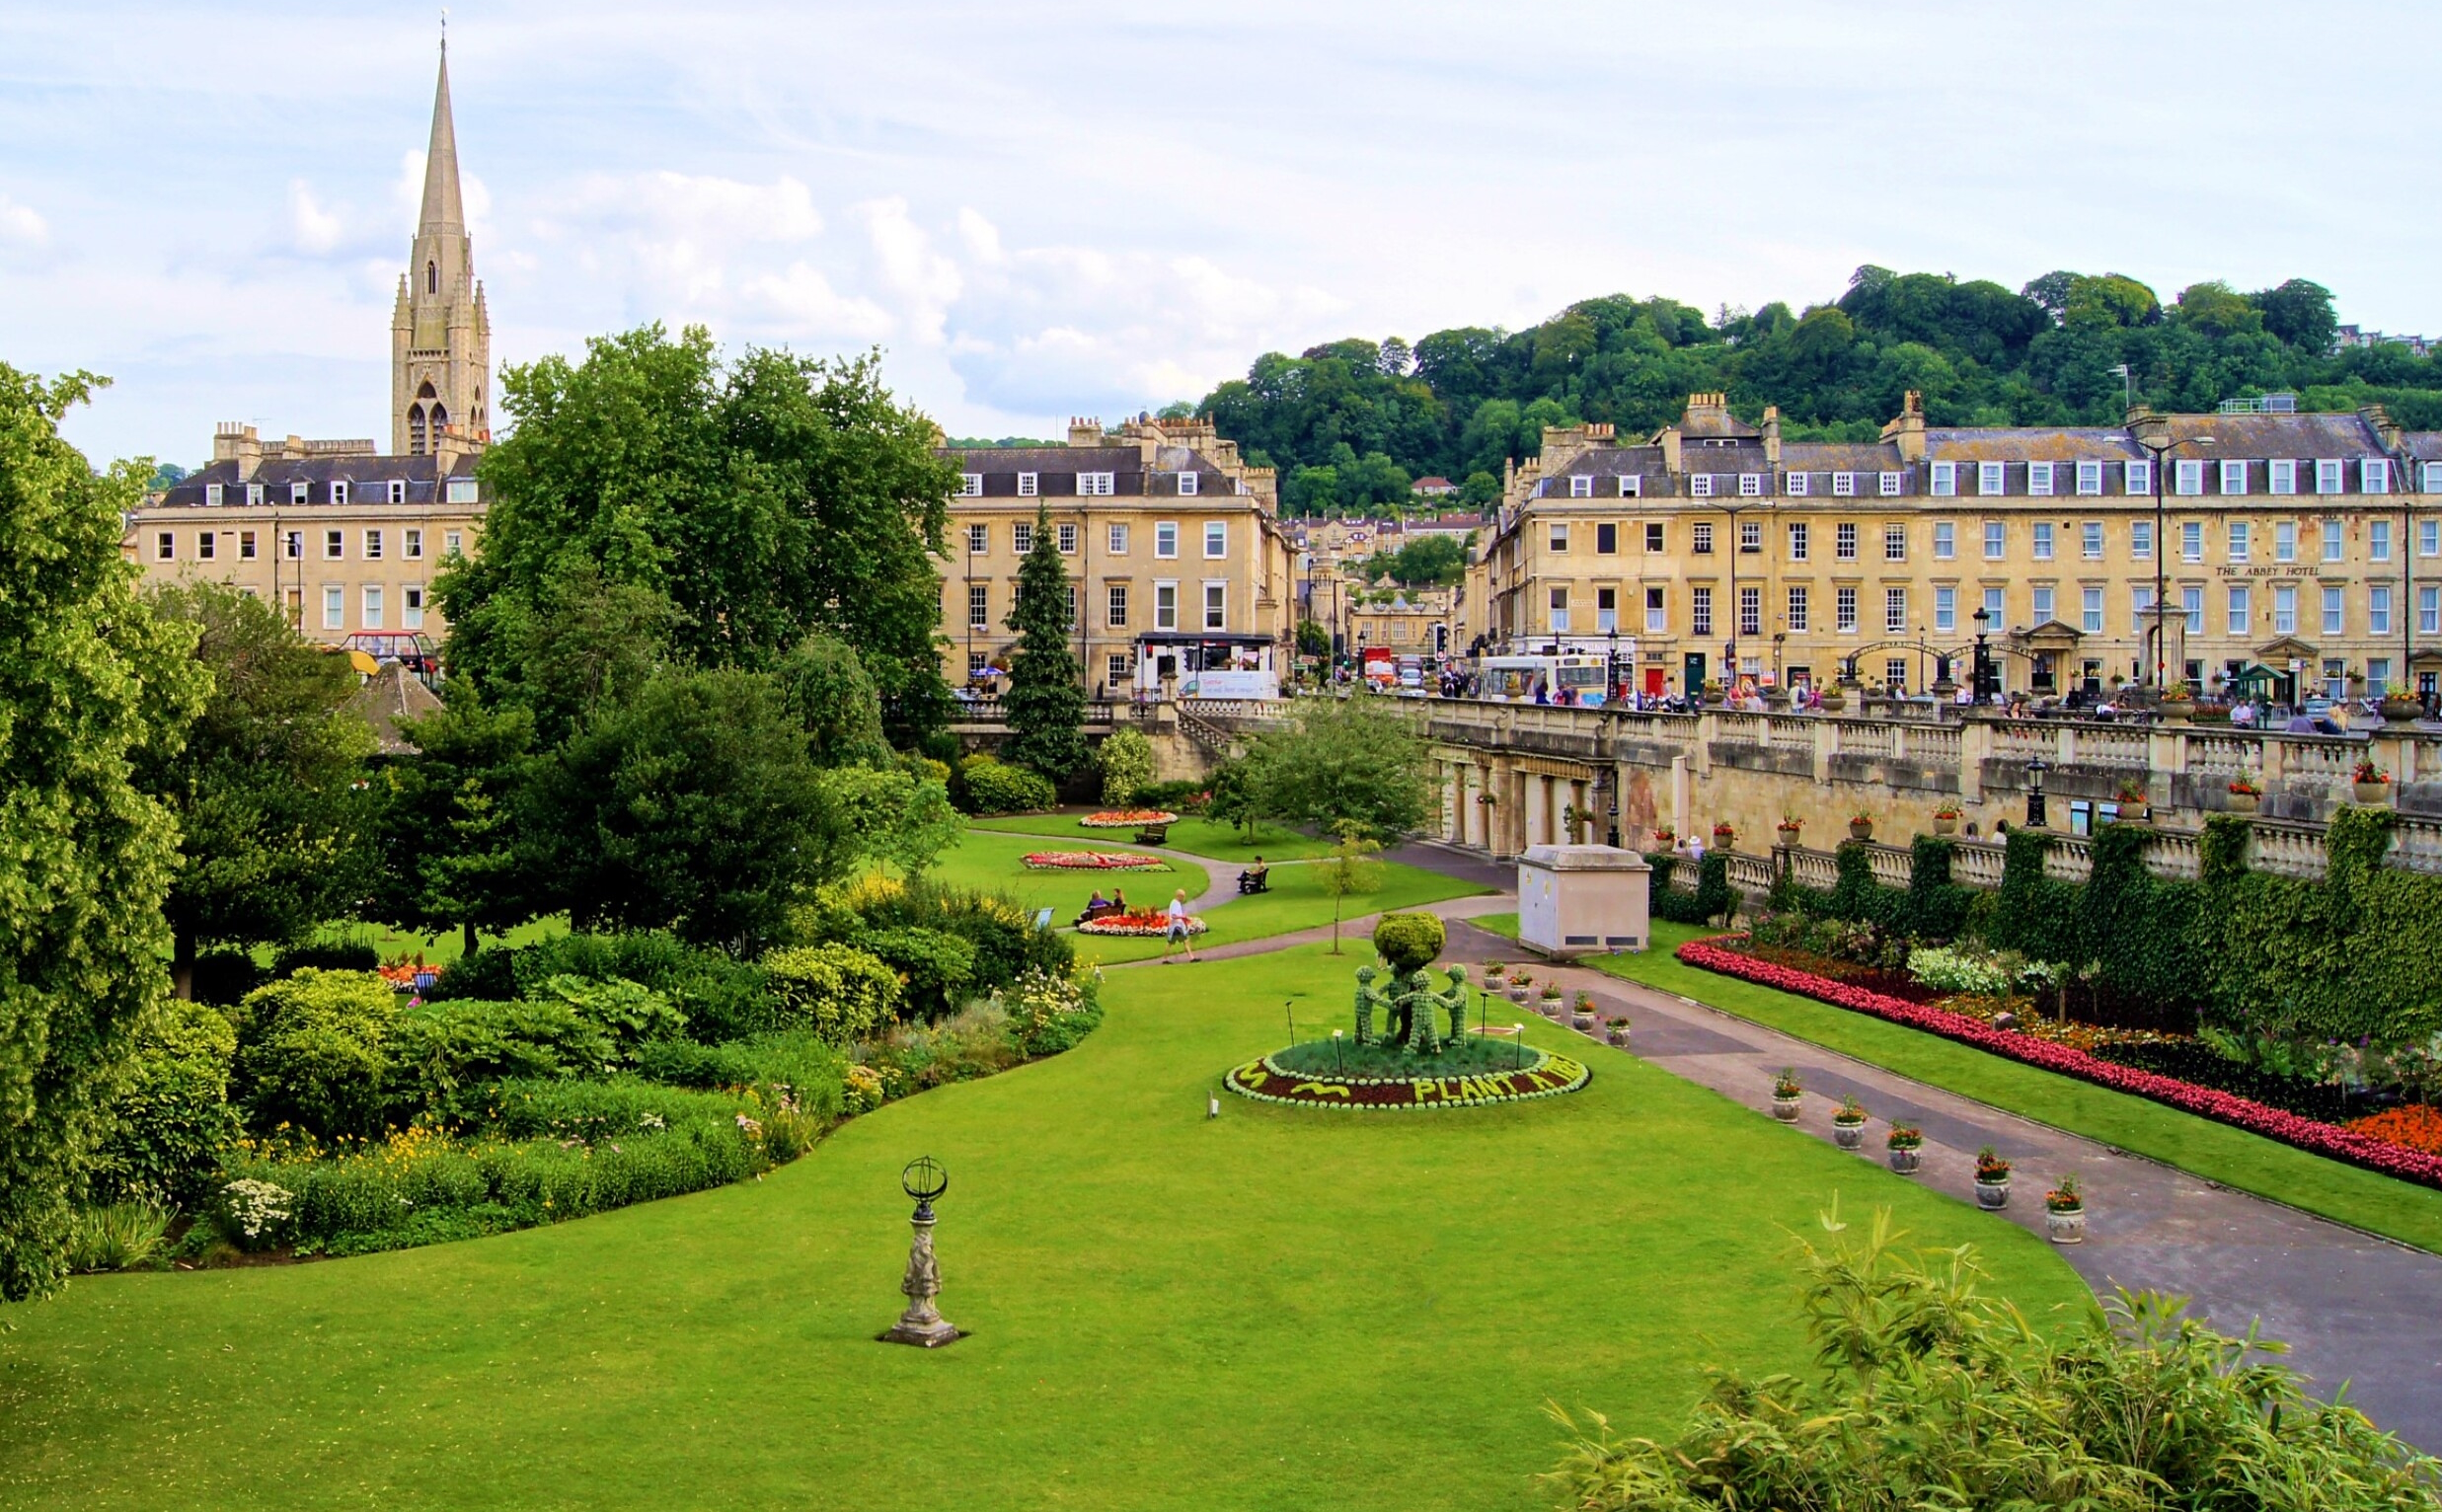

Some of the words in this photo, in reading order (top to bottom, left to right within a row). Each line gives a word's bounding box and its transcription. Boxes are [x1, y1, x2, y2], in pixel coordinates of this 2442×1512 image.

[2216, 567, 2238, 576] THE
[2245, 567, 2278, 576] ABBEY
[2286, 567, 2320, 576] HOTEL
[1413, 1074, 1518, 1101] PLANT
[1526, 1073, 1556, 1091] A
